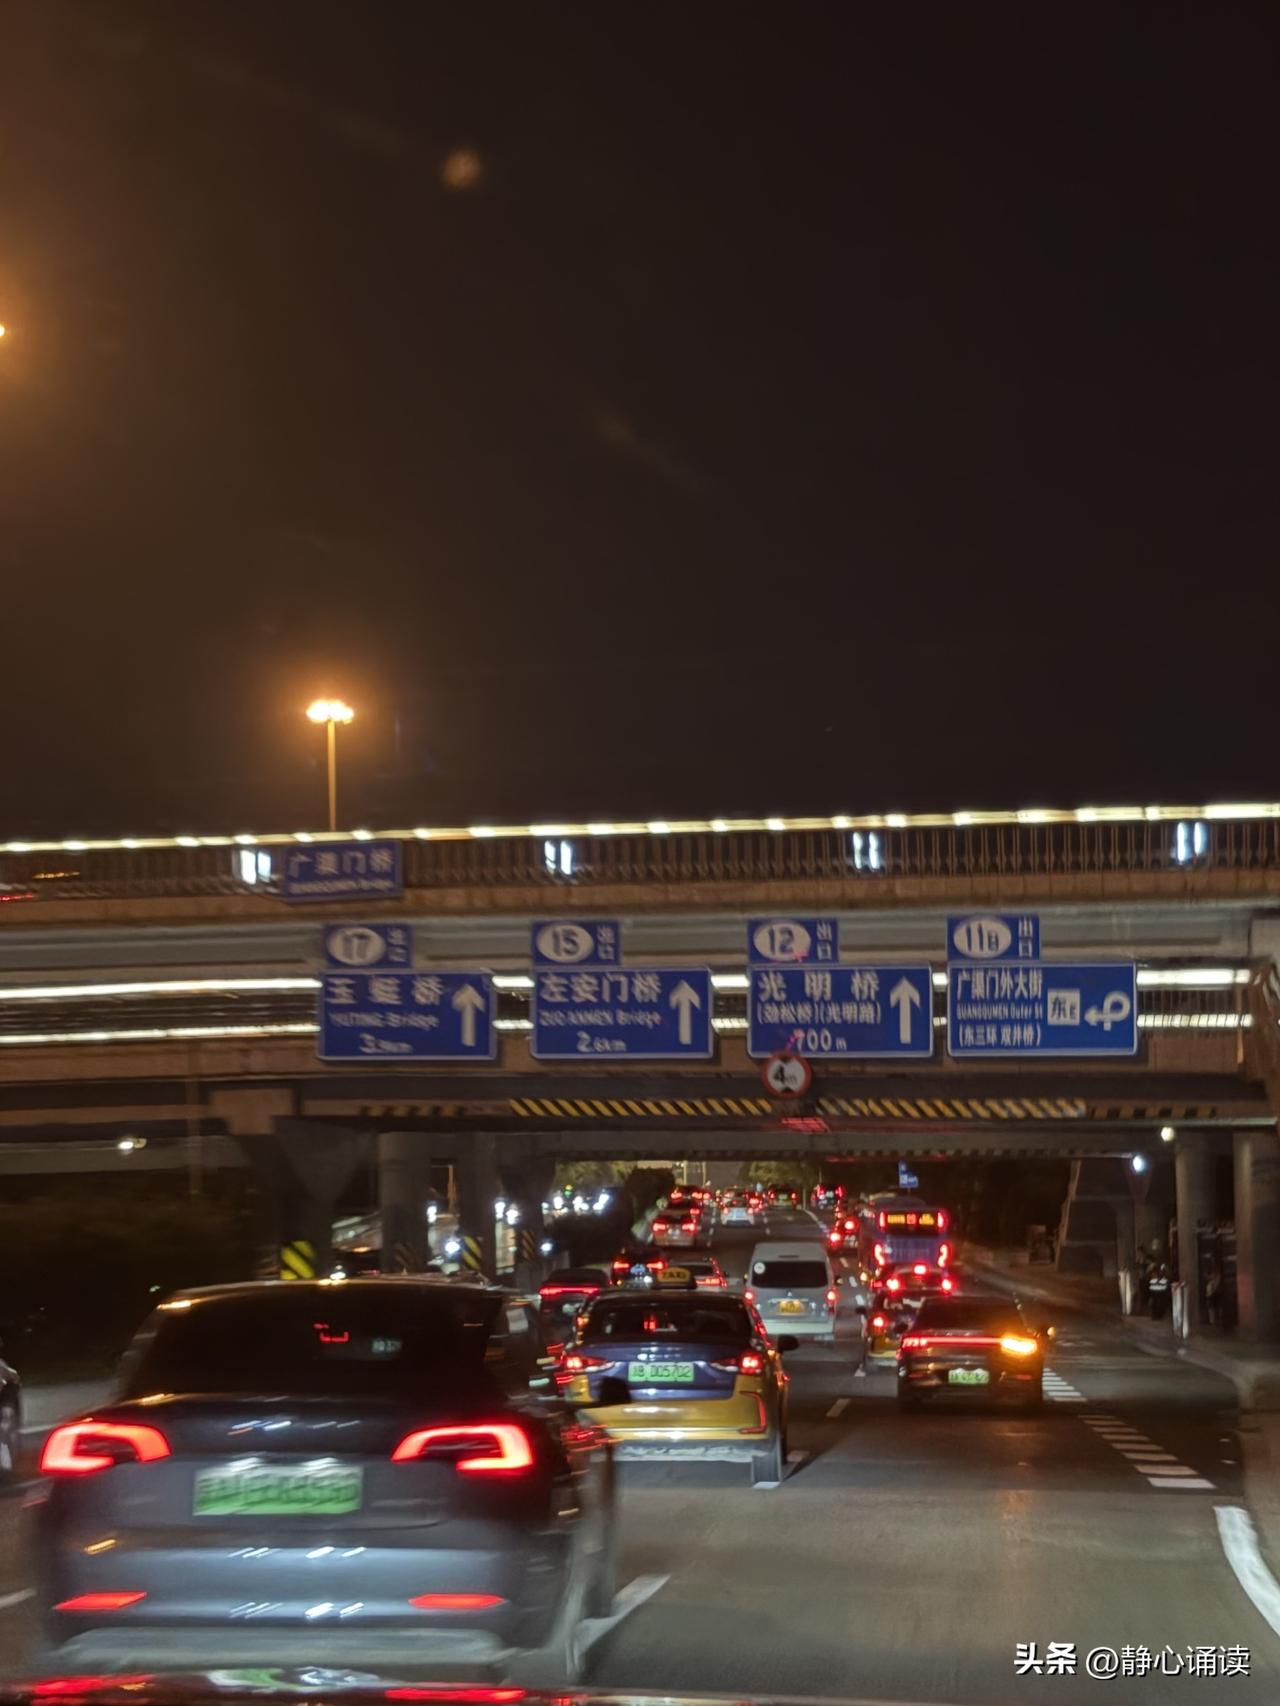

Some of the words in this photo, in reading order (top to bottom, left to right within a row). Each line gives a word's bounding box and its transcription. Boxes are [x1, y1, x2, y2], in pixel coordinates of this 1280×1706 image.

[552, 928, 580, 956] 15
[768, 927, 796, 956] 12
[816, 921, 832, 960] 出口
[1018, 917, 1033, 957] 出口
[539, 971, 662, 1003] 左安门桥
